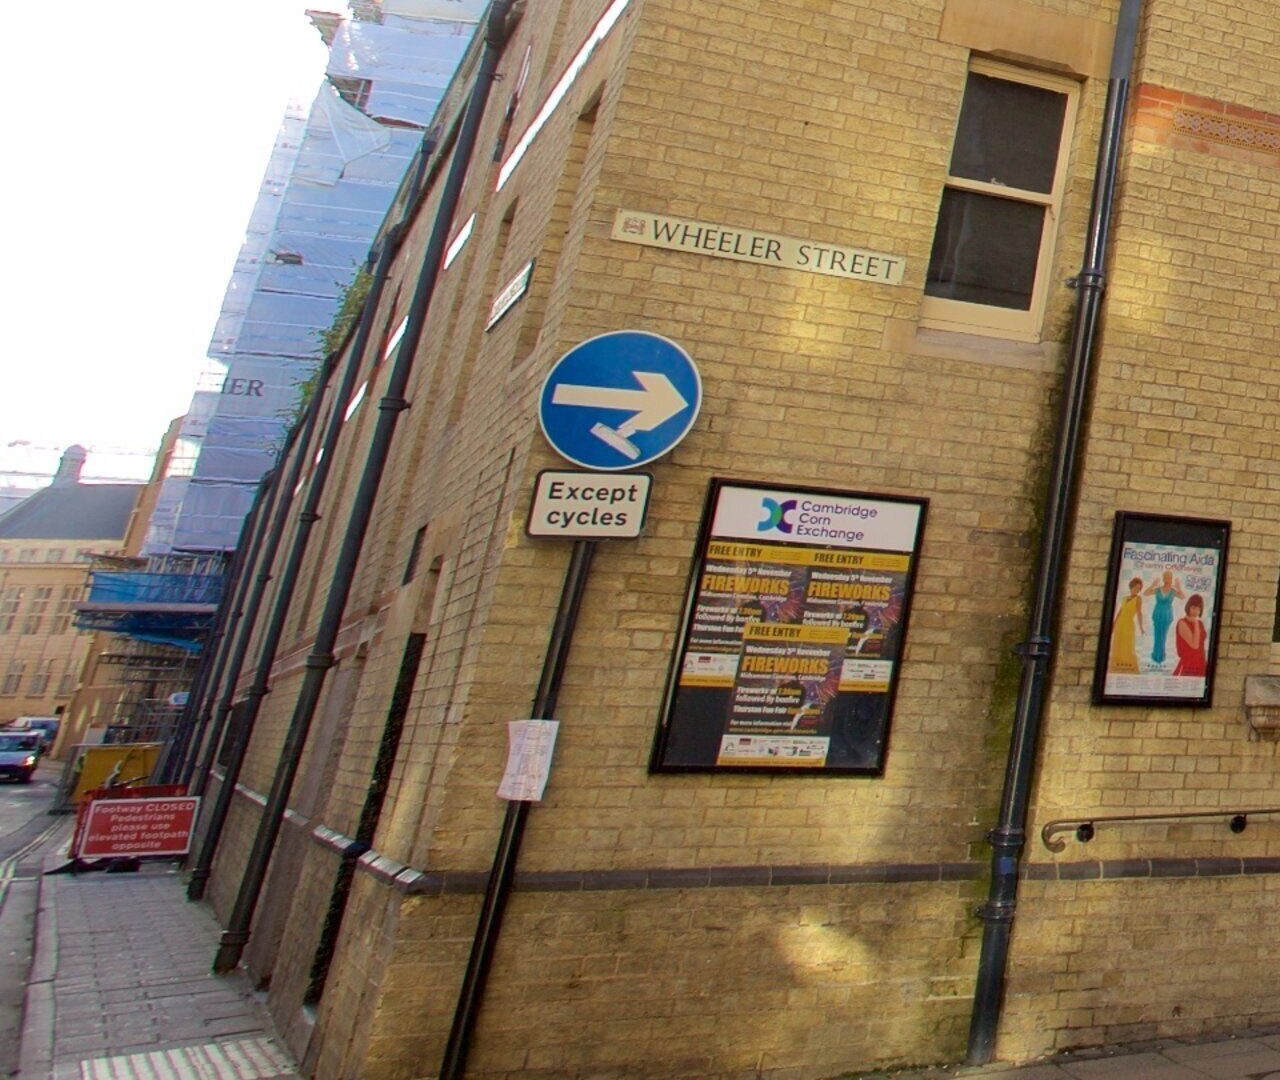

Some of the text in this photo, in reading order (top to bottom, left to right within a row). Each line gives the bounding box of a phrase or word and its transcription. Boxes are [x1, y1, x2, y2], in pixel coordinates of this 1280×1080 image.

[653, 219, 898, 279] WHEELER STREET
[549, 482, 638, 504] Except
[801, 501, 878, 518] Cambridge
[547, 507, 628, 528] cycles
[799, 512, 831, 526] Corn
[796, 525, 865, 542] Exchange
[709, 545, 733, 556] FREE
[733, 546, 762, 558] ENTRY
[814, 553, 835, 563] FREE
[836, 554, 864, 565] ENTRY
[1124, 547, 1188, 566] Fascinating
[702, 574, 790, 596] FIREWORKS
[808, 581, 891, 601] FIREWORKS
[749, 626, 770, 637] FREE
[773, 627, 802, 638] ENTRY
[741, 655, 829, 675] FIREWORKS
[95, 802, 195, 814] Footway CLOSED
[111, 813, 176, 822] Pedestrians
[88, 831, 189, 841] elevated footpath
[111, 824, 148, 833] please
[112, 841, 162, 850] opposite
